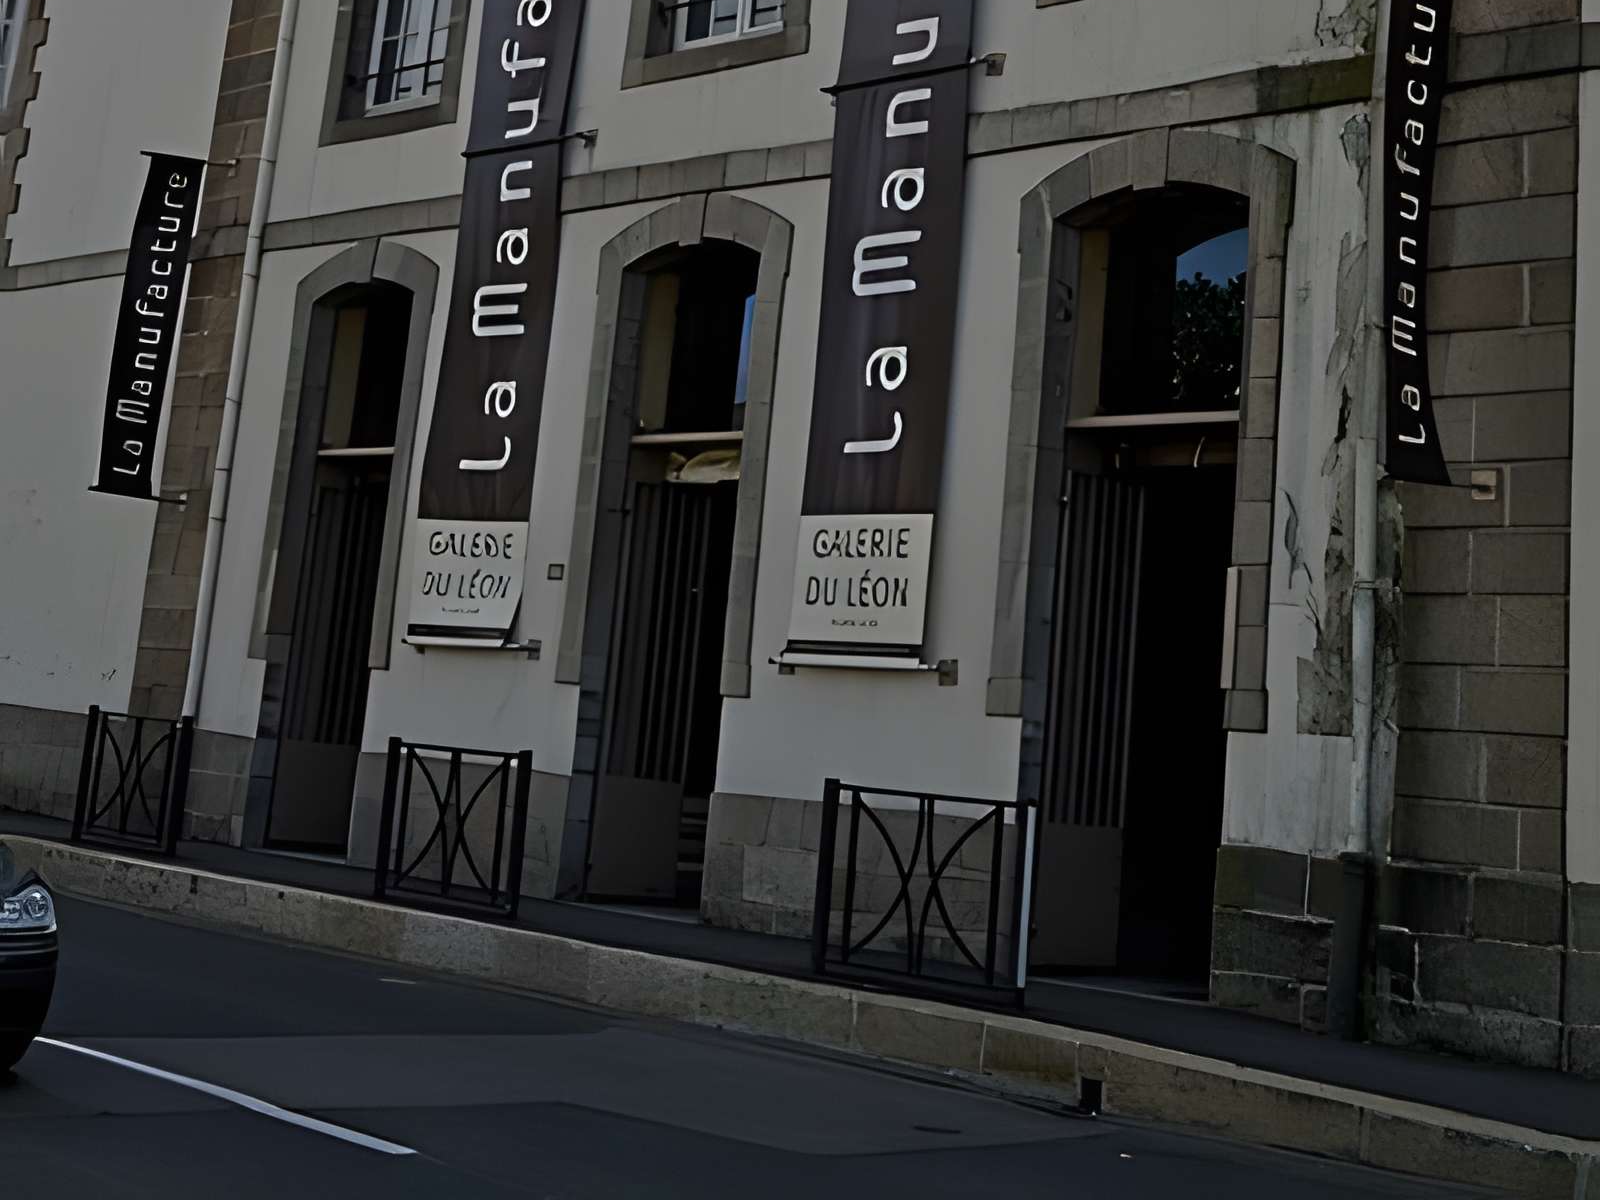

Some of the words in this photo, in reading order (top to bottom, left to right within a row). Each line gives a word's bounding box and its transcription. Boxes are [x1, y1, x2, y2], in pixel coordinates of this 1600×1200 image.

[115, 172, 188, 424] Manufacture
[843, 346, 908, 454] La
[1398, 384, 1426, 444] La
[458, 380, 517, 471] La
[112, 440, 143, 475] La
[812, 528, 910, 558] GALERIE
[422, 571, 452, 596] DU
[805, 576, 838, 606] DU
[847, 568, 909, 607] LÉON
